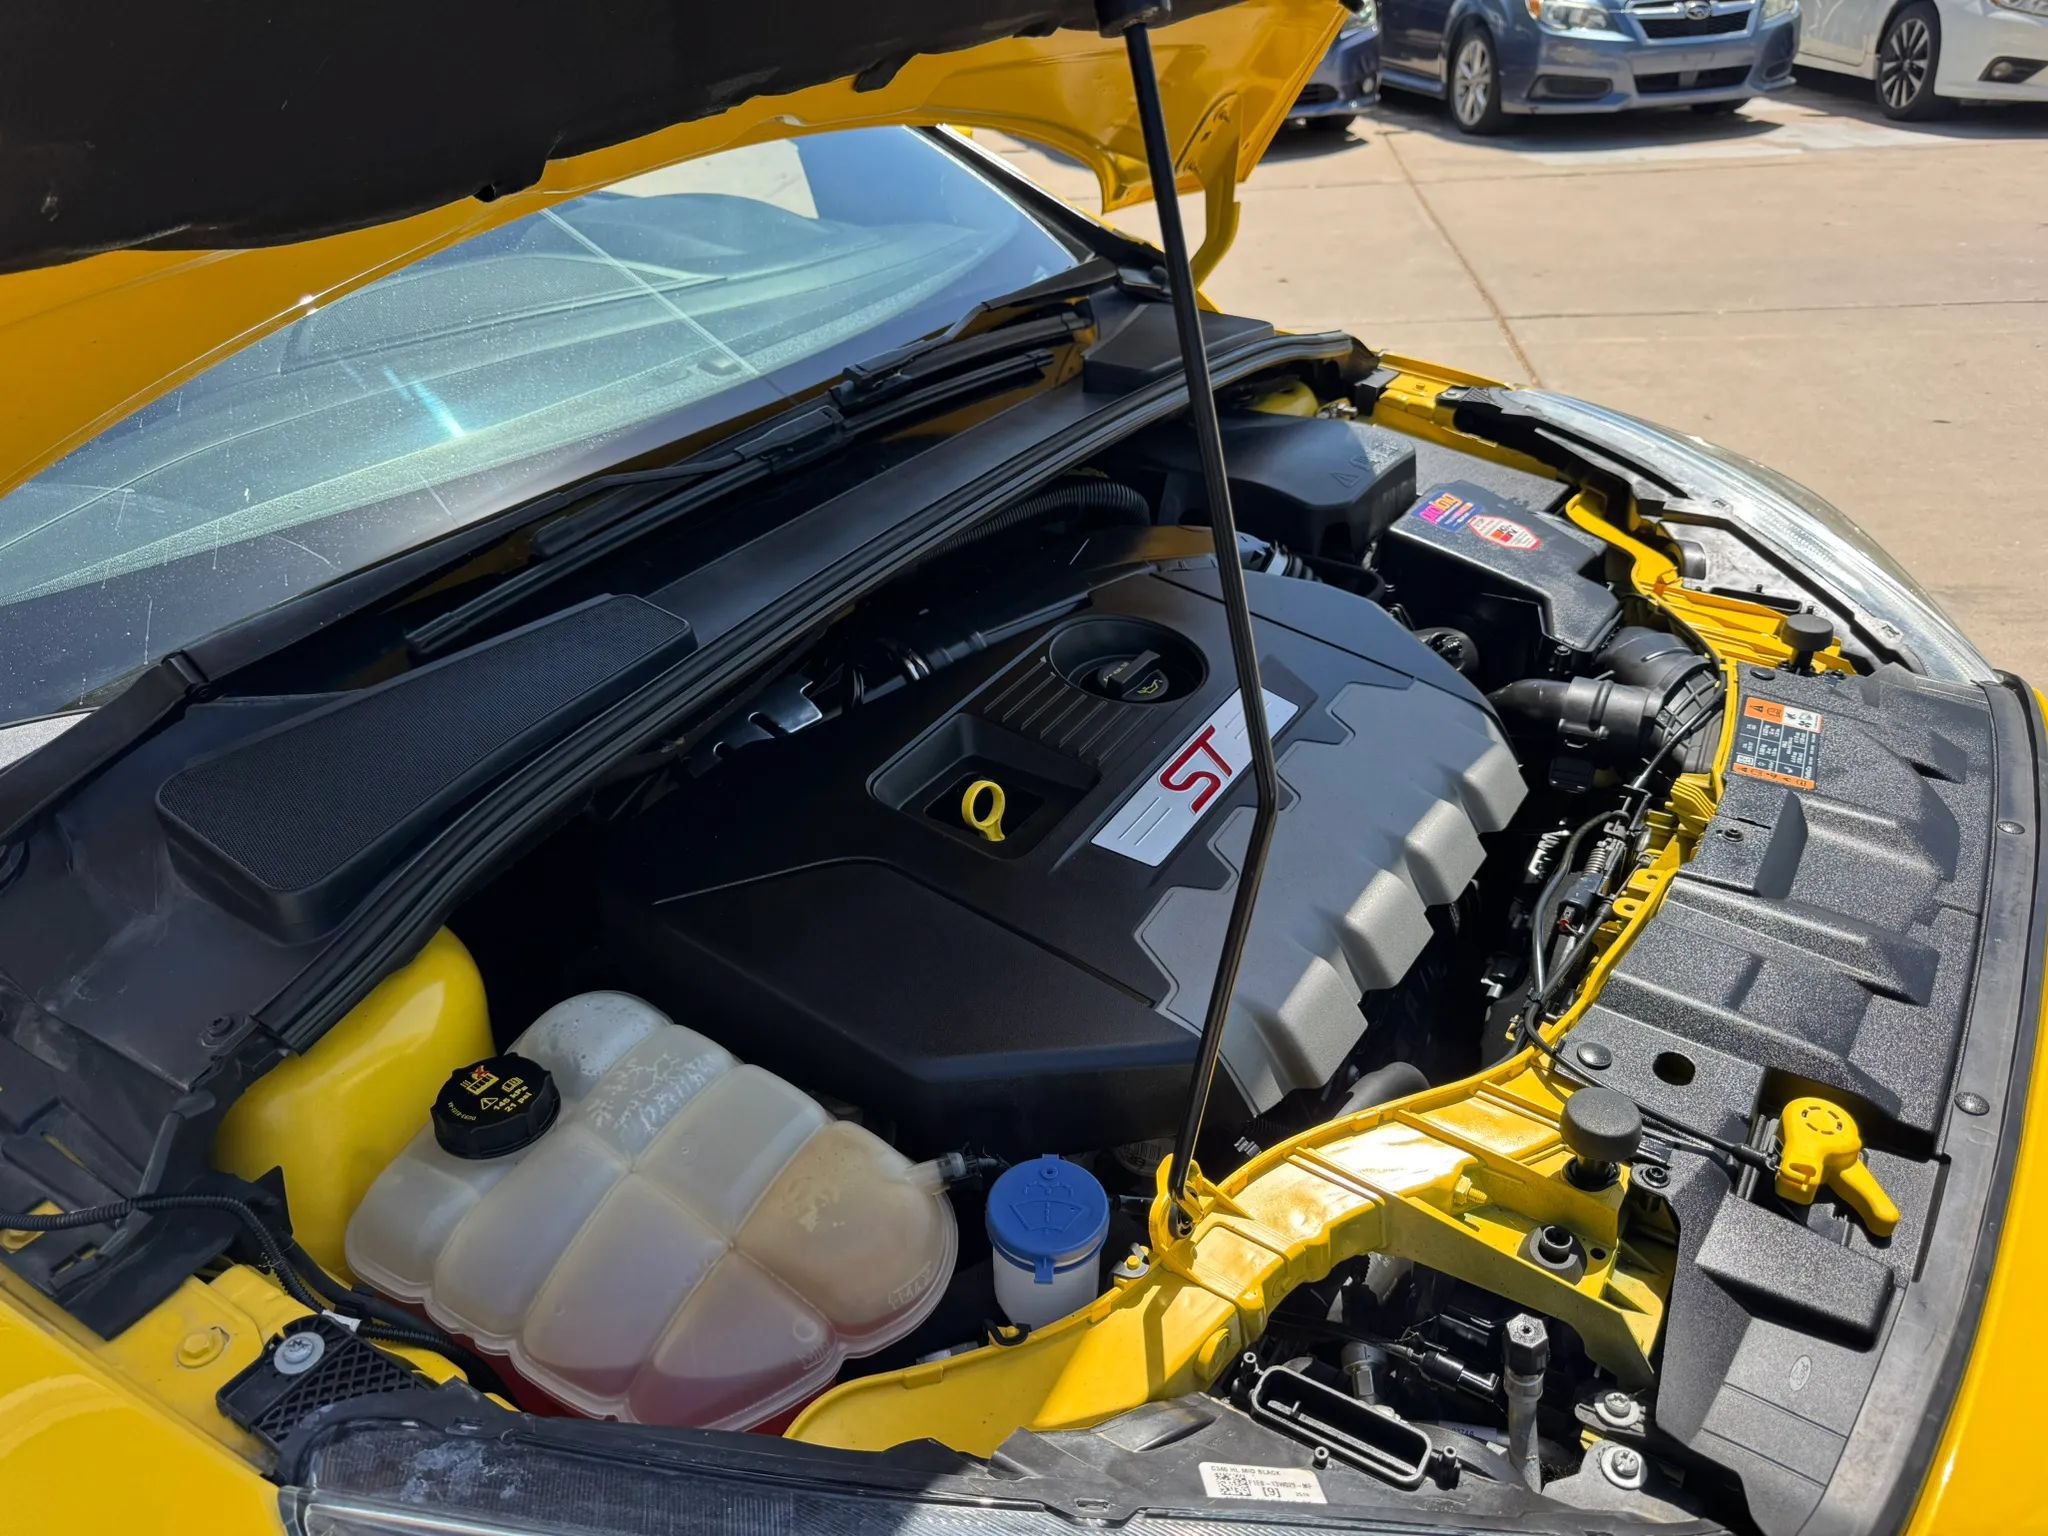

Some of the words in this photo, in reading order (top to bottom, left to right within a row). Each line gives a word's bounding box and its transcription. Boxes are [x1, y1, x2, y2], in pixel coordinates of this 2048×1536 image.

[1159, 723, 1233, 815] ST
[493, 1098, 511, 1111] 145
[509, 1085, 529, 1099] kPa
[504, 1103, 518, 1113] 21
[517, 1093, 533, 1105] psi
[1263, 1486, 1281, 1498] [9]
